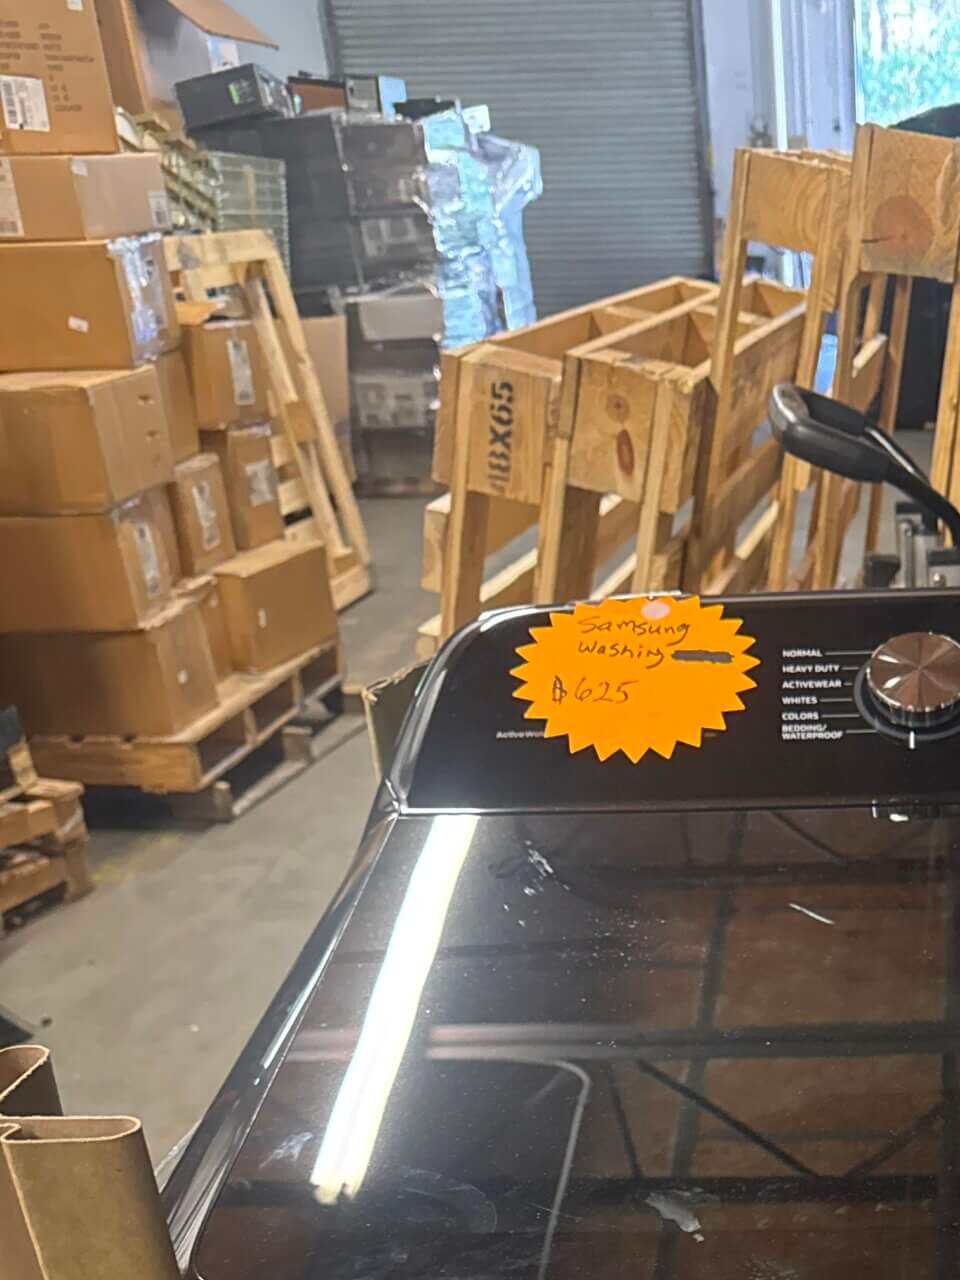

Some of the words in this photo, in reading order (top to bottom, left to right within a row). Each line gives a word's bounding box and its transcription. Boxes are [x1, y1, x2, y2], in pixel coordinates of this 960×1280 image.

[577, 616, 690, 646] Samsung
[782, 649, 823, 657] NORMAL
[782, 664, 813, 673] HEAVY
[815, 664, 840, 672] DUTY
[782, 680, 842, 689] ACTIVEWEAR
[782, 696, 818, 704] WHITES
[782, 712, 819, 720] COLORS
[782, 731, 843, 740] WATERPROOF
